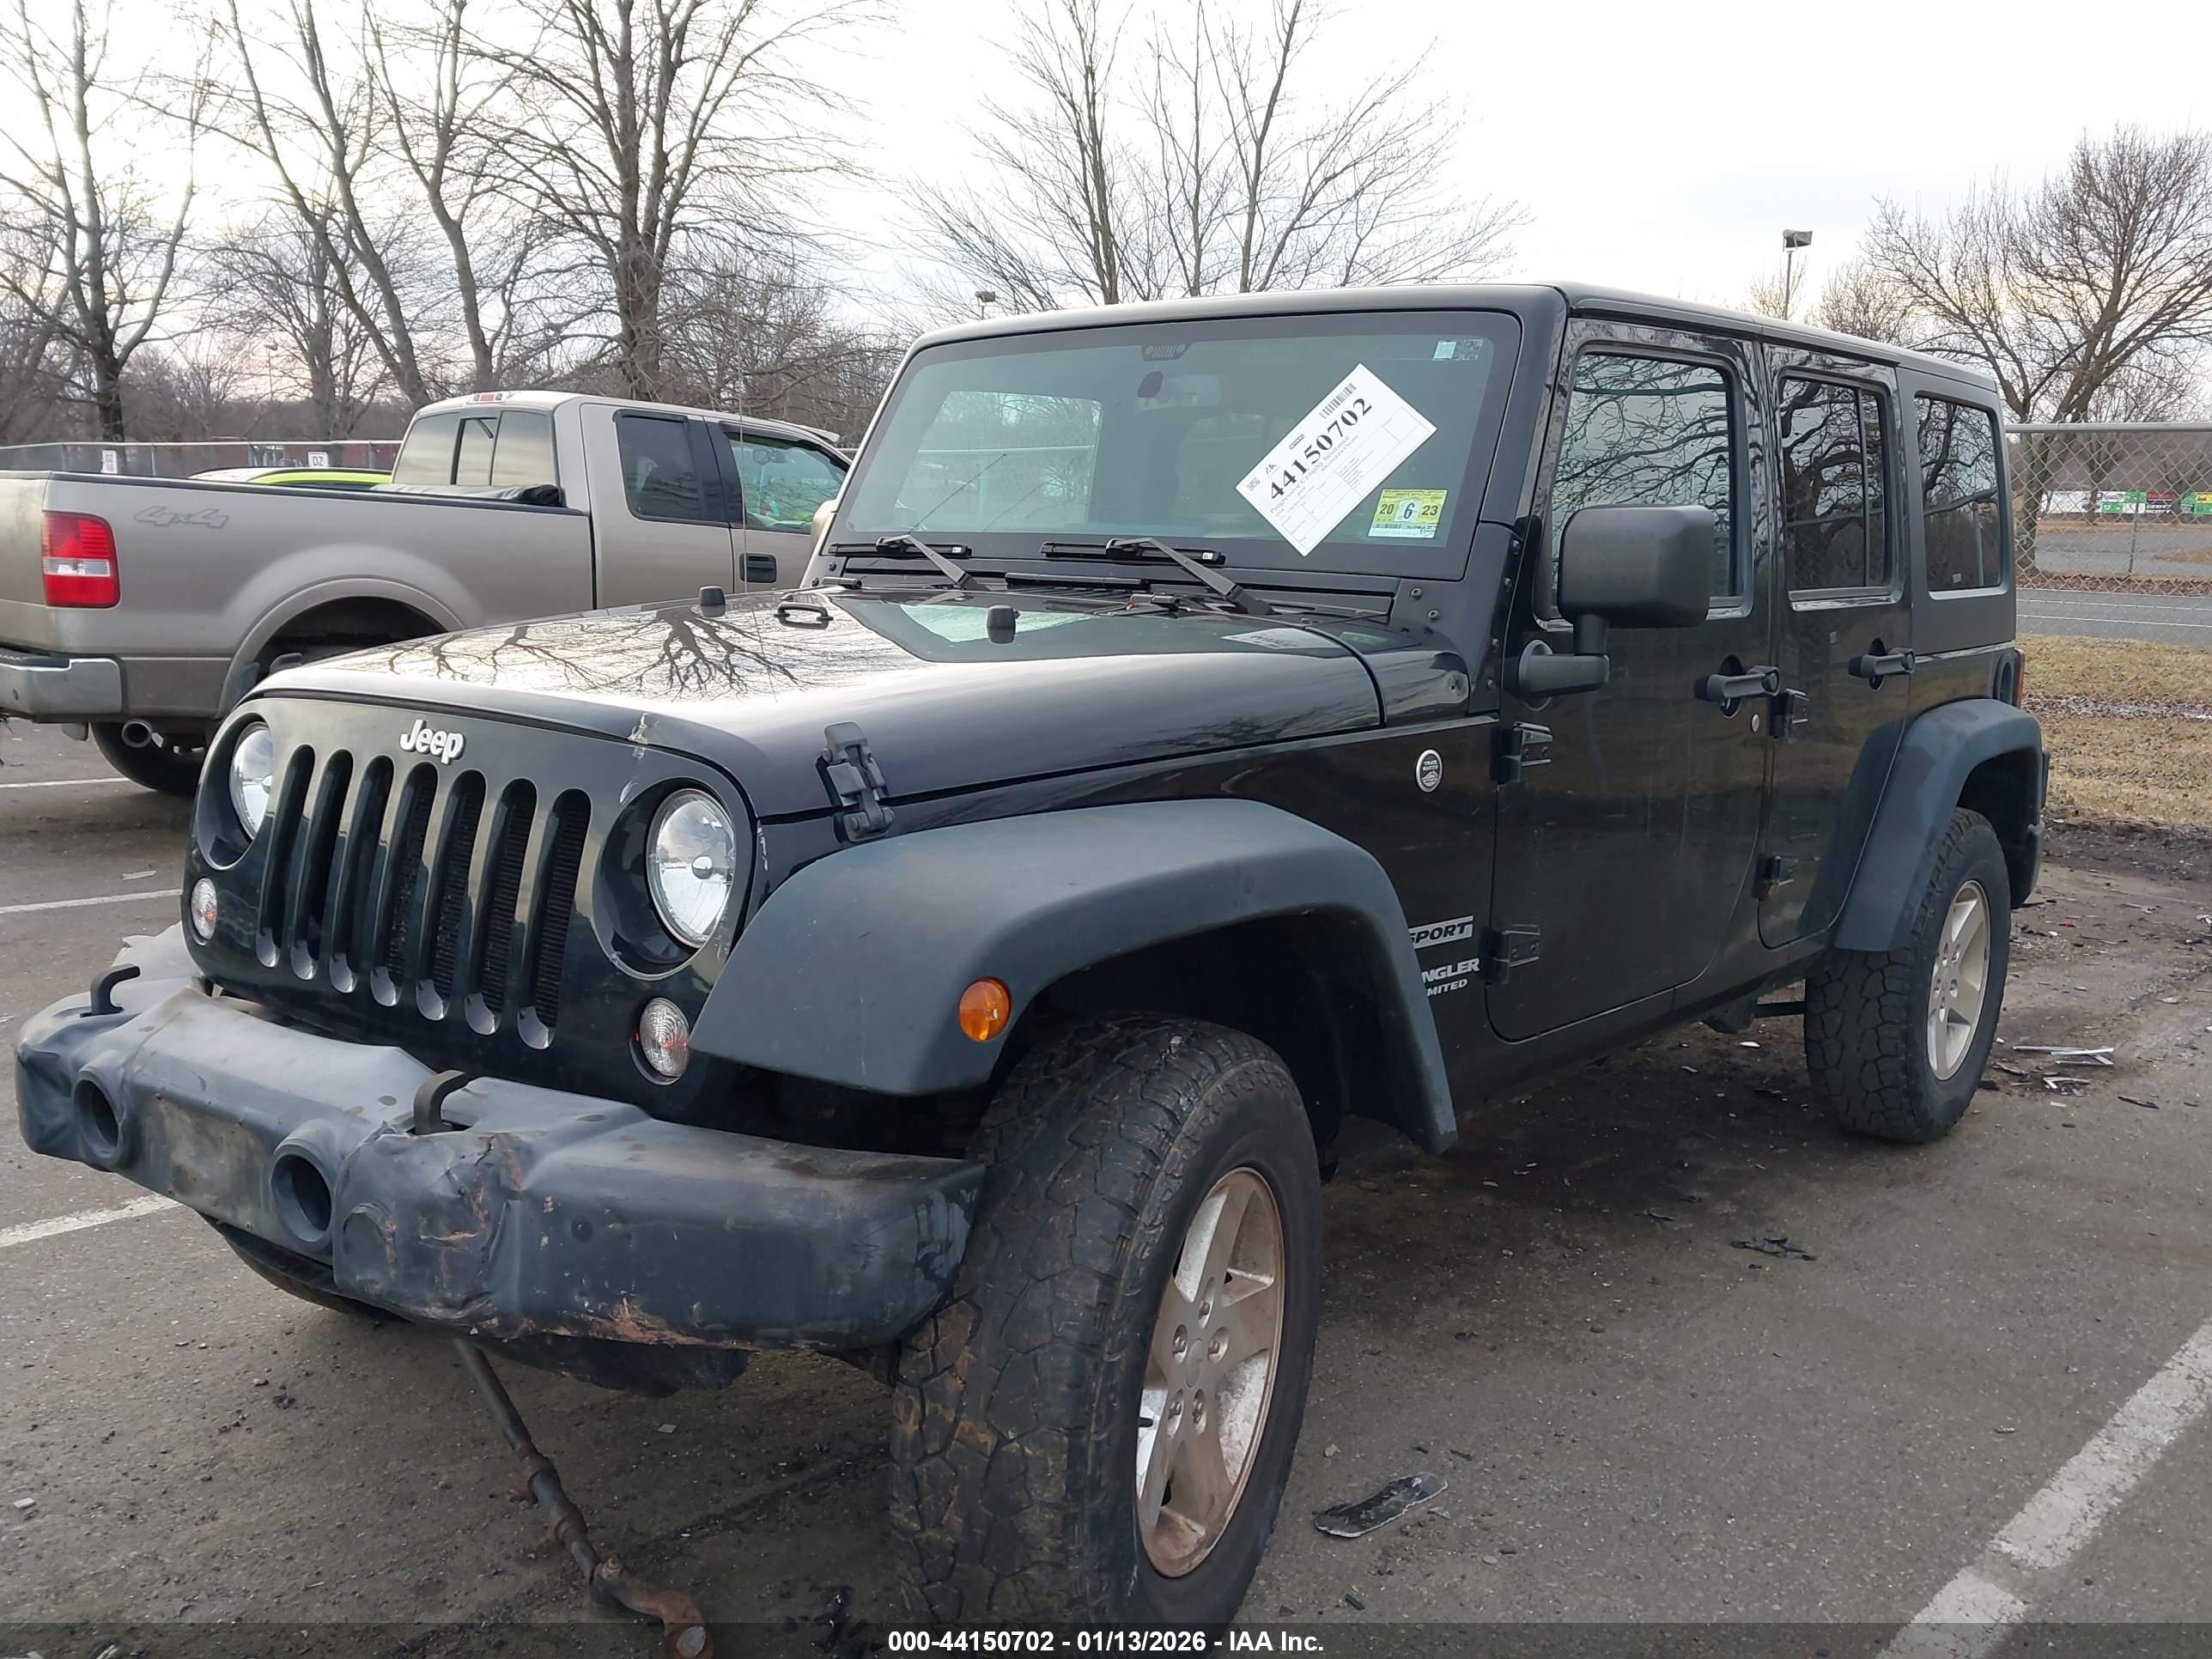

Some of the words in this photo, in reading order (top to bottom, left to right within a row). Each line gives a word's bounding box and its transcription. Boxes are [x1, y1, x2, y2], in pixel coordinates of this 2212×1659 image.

[1271, 398, 1372, 500] 44150702
[134, 506, 229, 528] 4x4
[1379, 503, 1395, 514] 20
[1403, 502, 1415, 520] 6
[1421, 505, 1438, 516] 23
[400, 719, 465, 765] Jeep
[1422, 957, 1480, 983] NGLER
[1426, 979, 1468, 996] MITED
